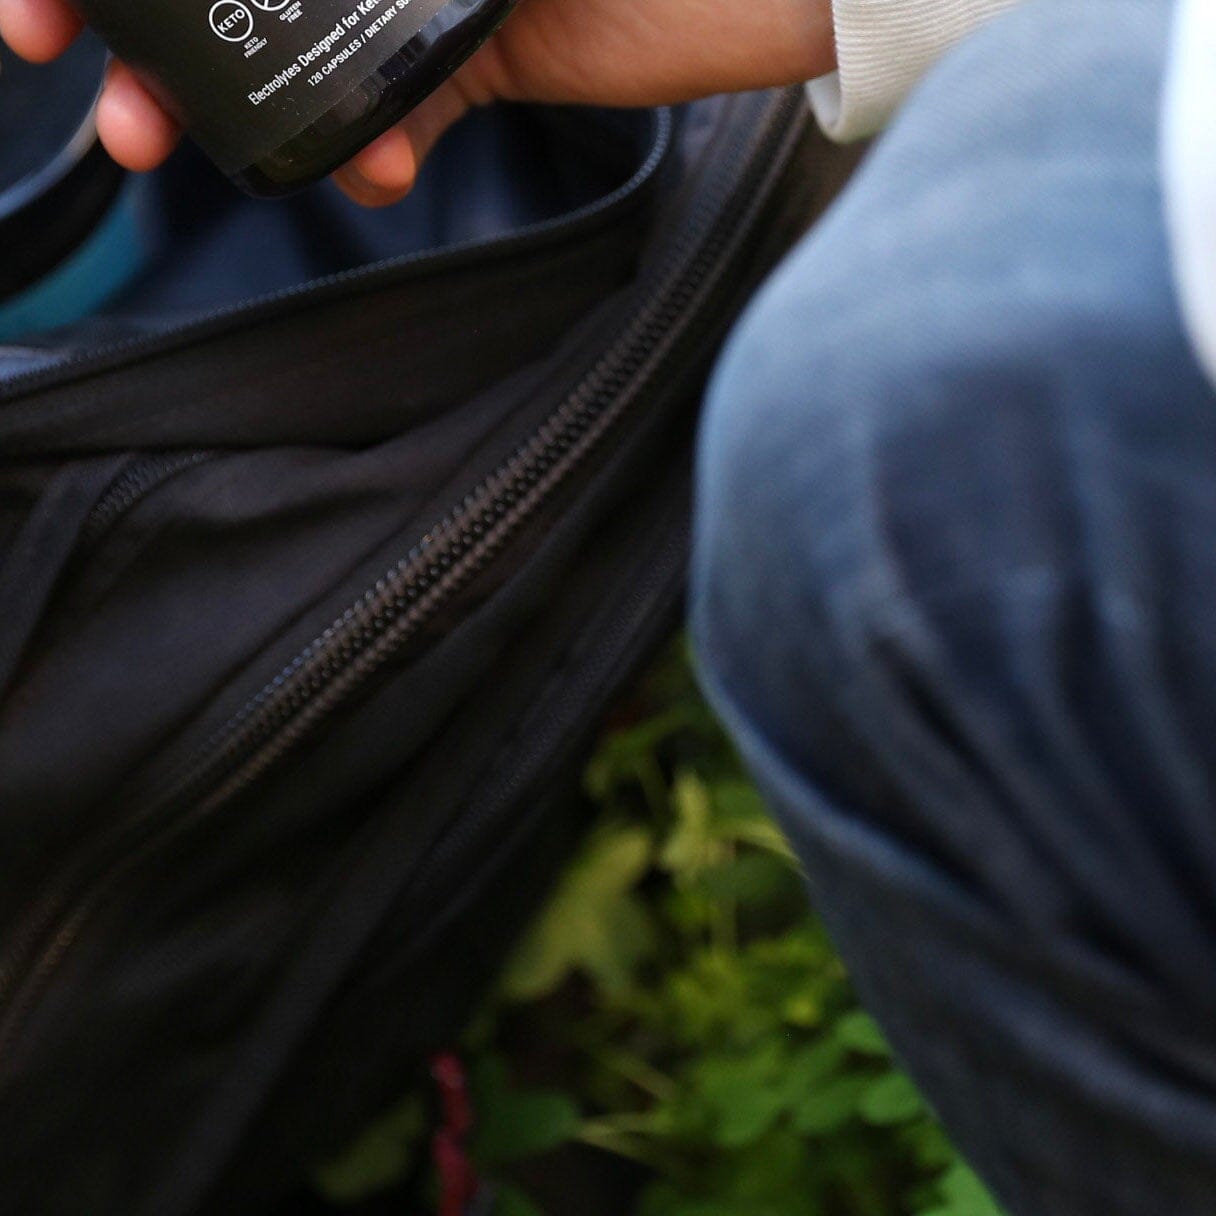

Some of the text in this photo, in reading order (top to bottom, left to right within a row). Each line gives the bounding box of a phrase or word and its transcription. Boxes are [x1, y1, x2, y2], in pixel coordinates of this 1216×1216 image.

[217, 8, 246, 33] KETO
[279, 0, 302, 21] GLUTEN
[287, 9, 303, 23] FREE
[243, 37, 259, 49] KETO
[308, 72, 324, 87] 120
[321, 39, 362, 75] CAPSULES
[360, 34, 368, 44] /
[364, 6, 398, 39] DIETARY
[248, 63, 302, 106] Electrolytes
[297, 23, 346, 67] Designed
[342, 10, 361, 29] for
